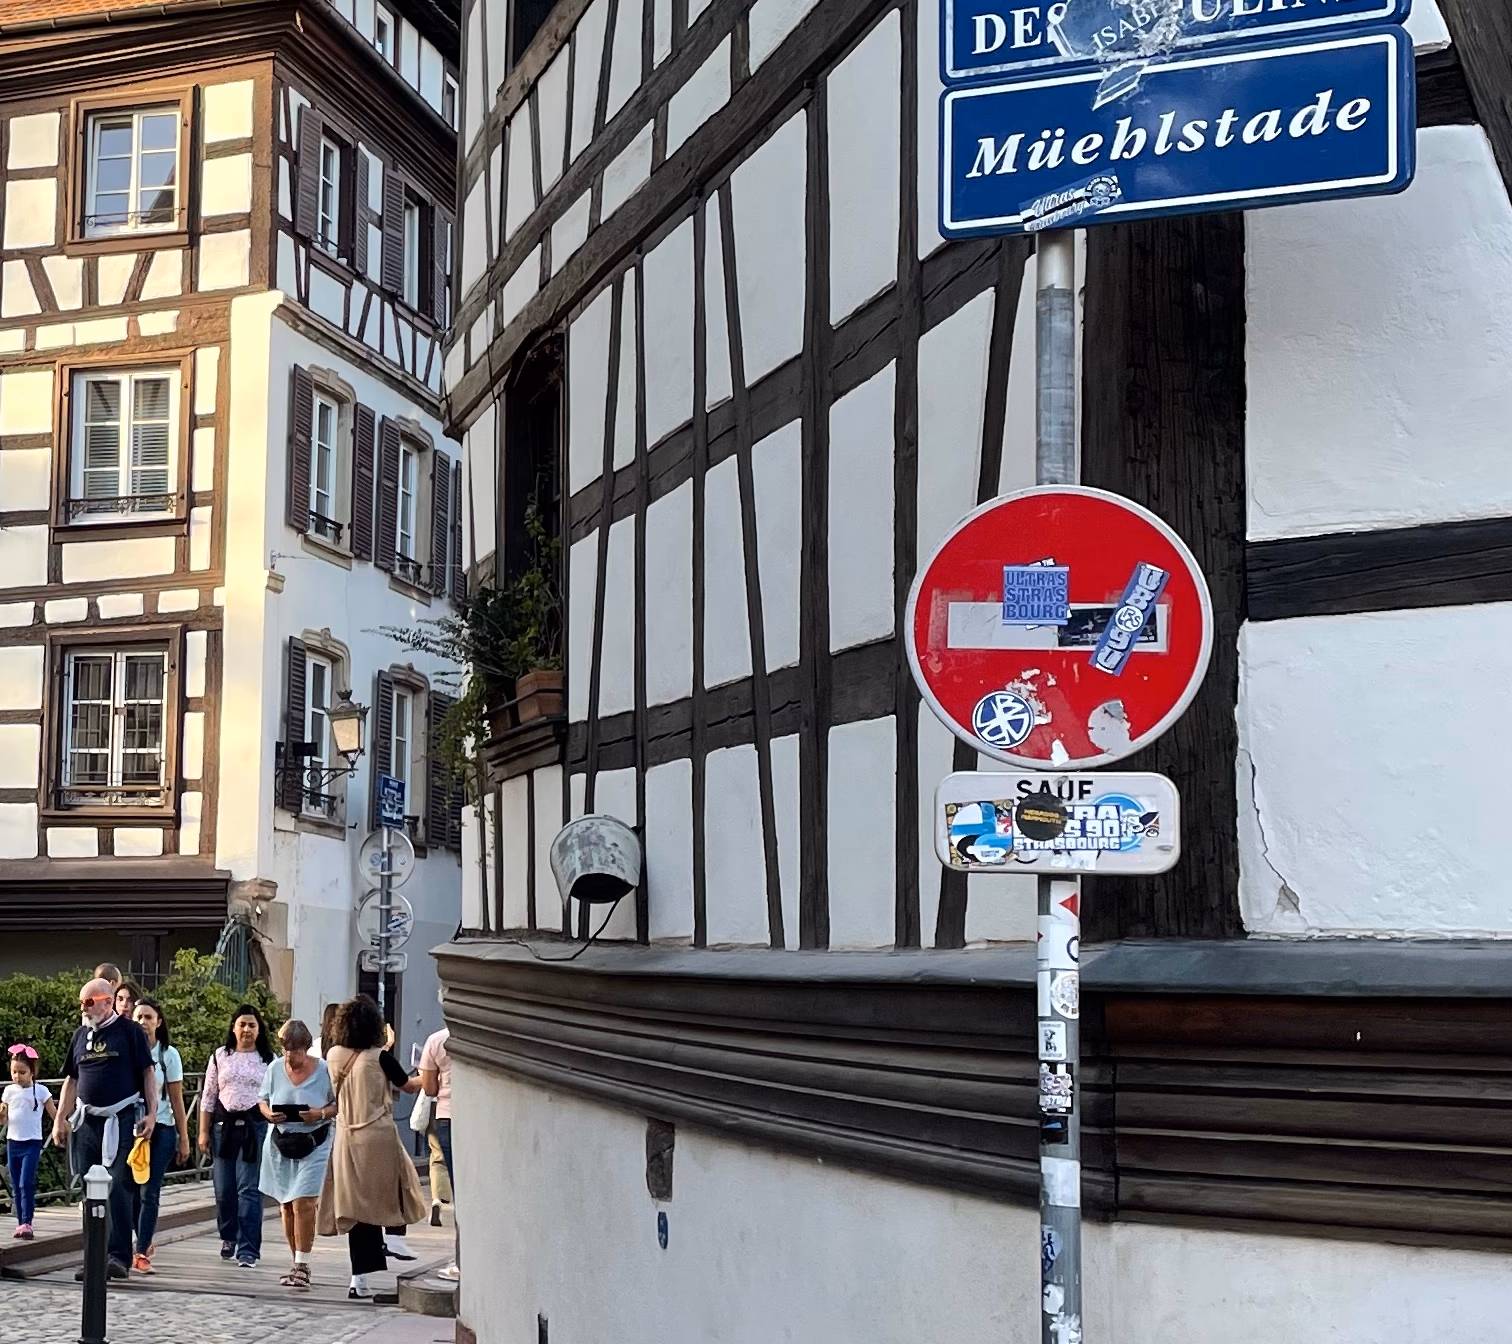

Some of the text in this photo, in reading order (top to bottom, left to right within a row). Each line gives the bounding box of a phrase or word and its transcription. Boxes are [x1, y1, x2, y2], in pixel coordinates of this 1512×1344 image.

[965, 89, 1372, 179] Müehlstade
[1005, 571, 1067, 586] ULTRAS
[1005, 587, 1066, 603] STRAS
[1005, 603, 1067, 619] BOURG
[1016, 779, 1094, 801] SAUF
[1013, 837, 1120, 850] STRASBOURG
